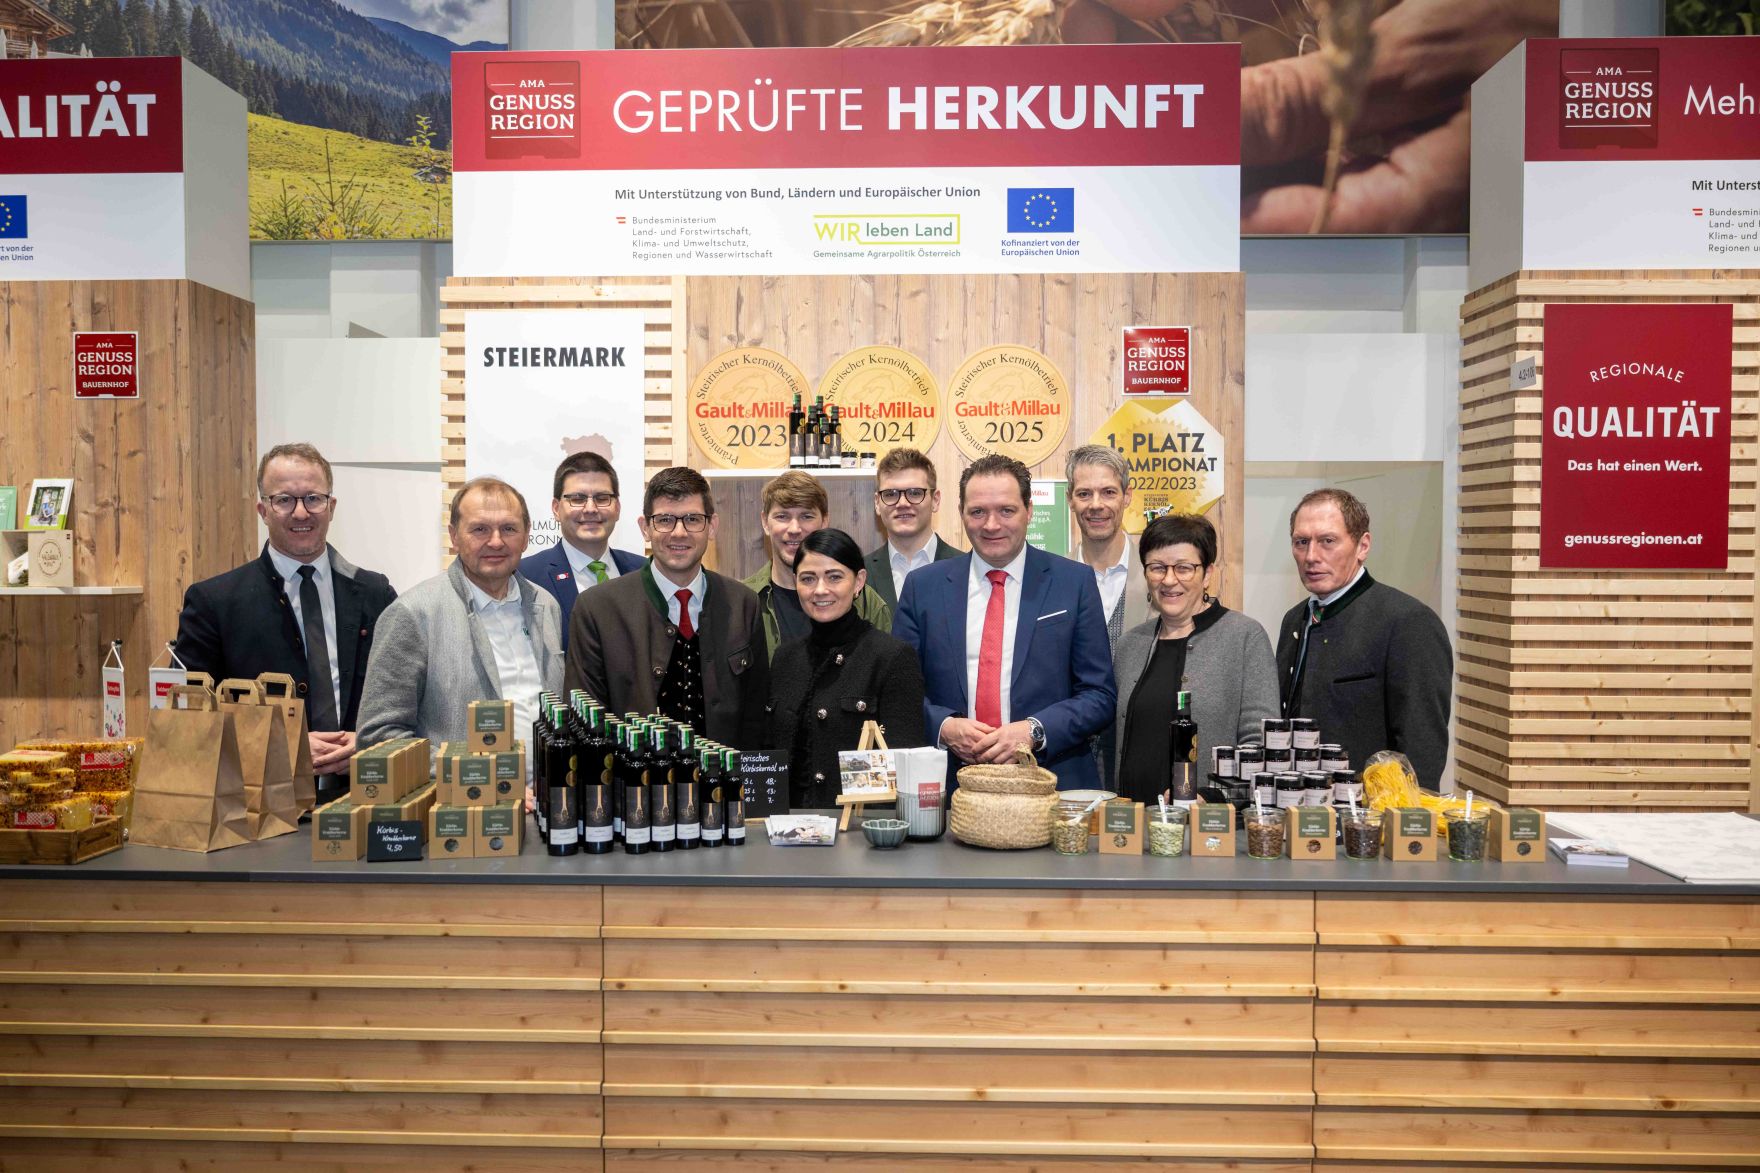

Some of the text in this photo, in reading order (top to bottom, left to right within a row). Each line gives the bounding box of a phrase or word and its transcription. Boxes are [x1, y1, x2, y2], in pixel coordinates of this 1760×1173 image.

[1596, 67, 1623, 76] AMA
[519, 79, 546, 88] AMA
[1565, 82, 1653, 99] GENUSS
[489, 93, 576, 111] GENUSS
[612, 77, 1204, 134] GEPRÜFTE HERKUNFT
[1683, 82, 1760, 115] Meh
[1565, 102, 1652, 119] REGION
[490, 113, 575, 131] REGION
[1692, 180, 1713, 191] Mit
[614, 186, 981, 202] Mit Unterstützung von Bund, Ländern und Europäischer Union
[631, 215, 717, 225] Bundesministerium
[1709, 219, 1734, 228] Land-
[1738, 219, 1755, 228] und
[631, 227, 752, 238] Land- und Forstwirtschaft,
[814, 219, 953, 242] WIR leben Land
[1708, 231, 1758, 240] Klima- und
[21, 244, 34, 252] der
[632, 238, 749, 250] Klima- und Umweltschutz,
[1001, 238, 1080, 248] Kofinanziert von der
[1708, 243, 1750, 254] Regionen
[11, 253, 34, 261] Union
[632, 249, 773, 262] Regionen und Wasserwirtschaft
[813, 247, 961, 261] Gemeinsame Agrarpolitik Österreich
[1001, 247, 1080, 259] Europäischen Union
[1148, 336, 1166, 344] AMA
[77, 351, 133, 363] GENUSS
[483, 346, 626, 368] STEIERMARK
[1127, 347, 1187, 359] GENUSS
[78, 364, 133, 376] REGION
[1128, 360, 1186, 372] REGION
[1590, 362, 1685, 383] REGIONALE
[696, 358, 740, 400] Steirischer
[825, 353, 930, 401] Steirischer Kernölbetrieb
[955, 356, 997, 399] Steirischer
[1000, 353, 1059, 396] Kernölbetrieb
[1131, 377, 1182, 385] BAUERNHOF
[82, 381, 130, 389] BAUERNHOF
[955, 400, 1061, 417] Gault&Millau
[1552, 400, 1720, 439] QUALITÄT
[726, 424, 788, 447] 2023
[858, 421, 916, 443] 2024
[985, 421, 1044, 443] 2025
[698, 422, 740, 466] Prämierter
[1107, 433, 1205, 453] 1. PLATZ
[1567, 458, 1703, 472] Das hat einen Wert.
[1564, 532, 1703, 548] genussregionen.at
